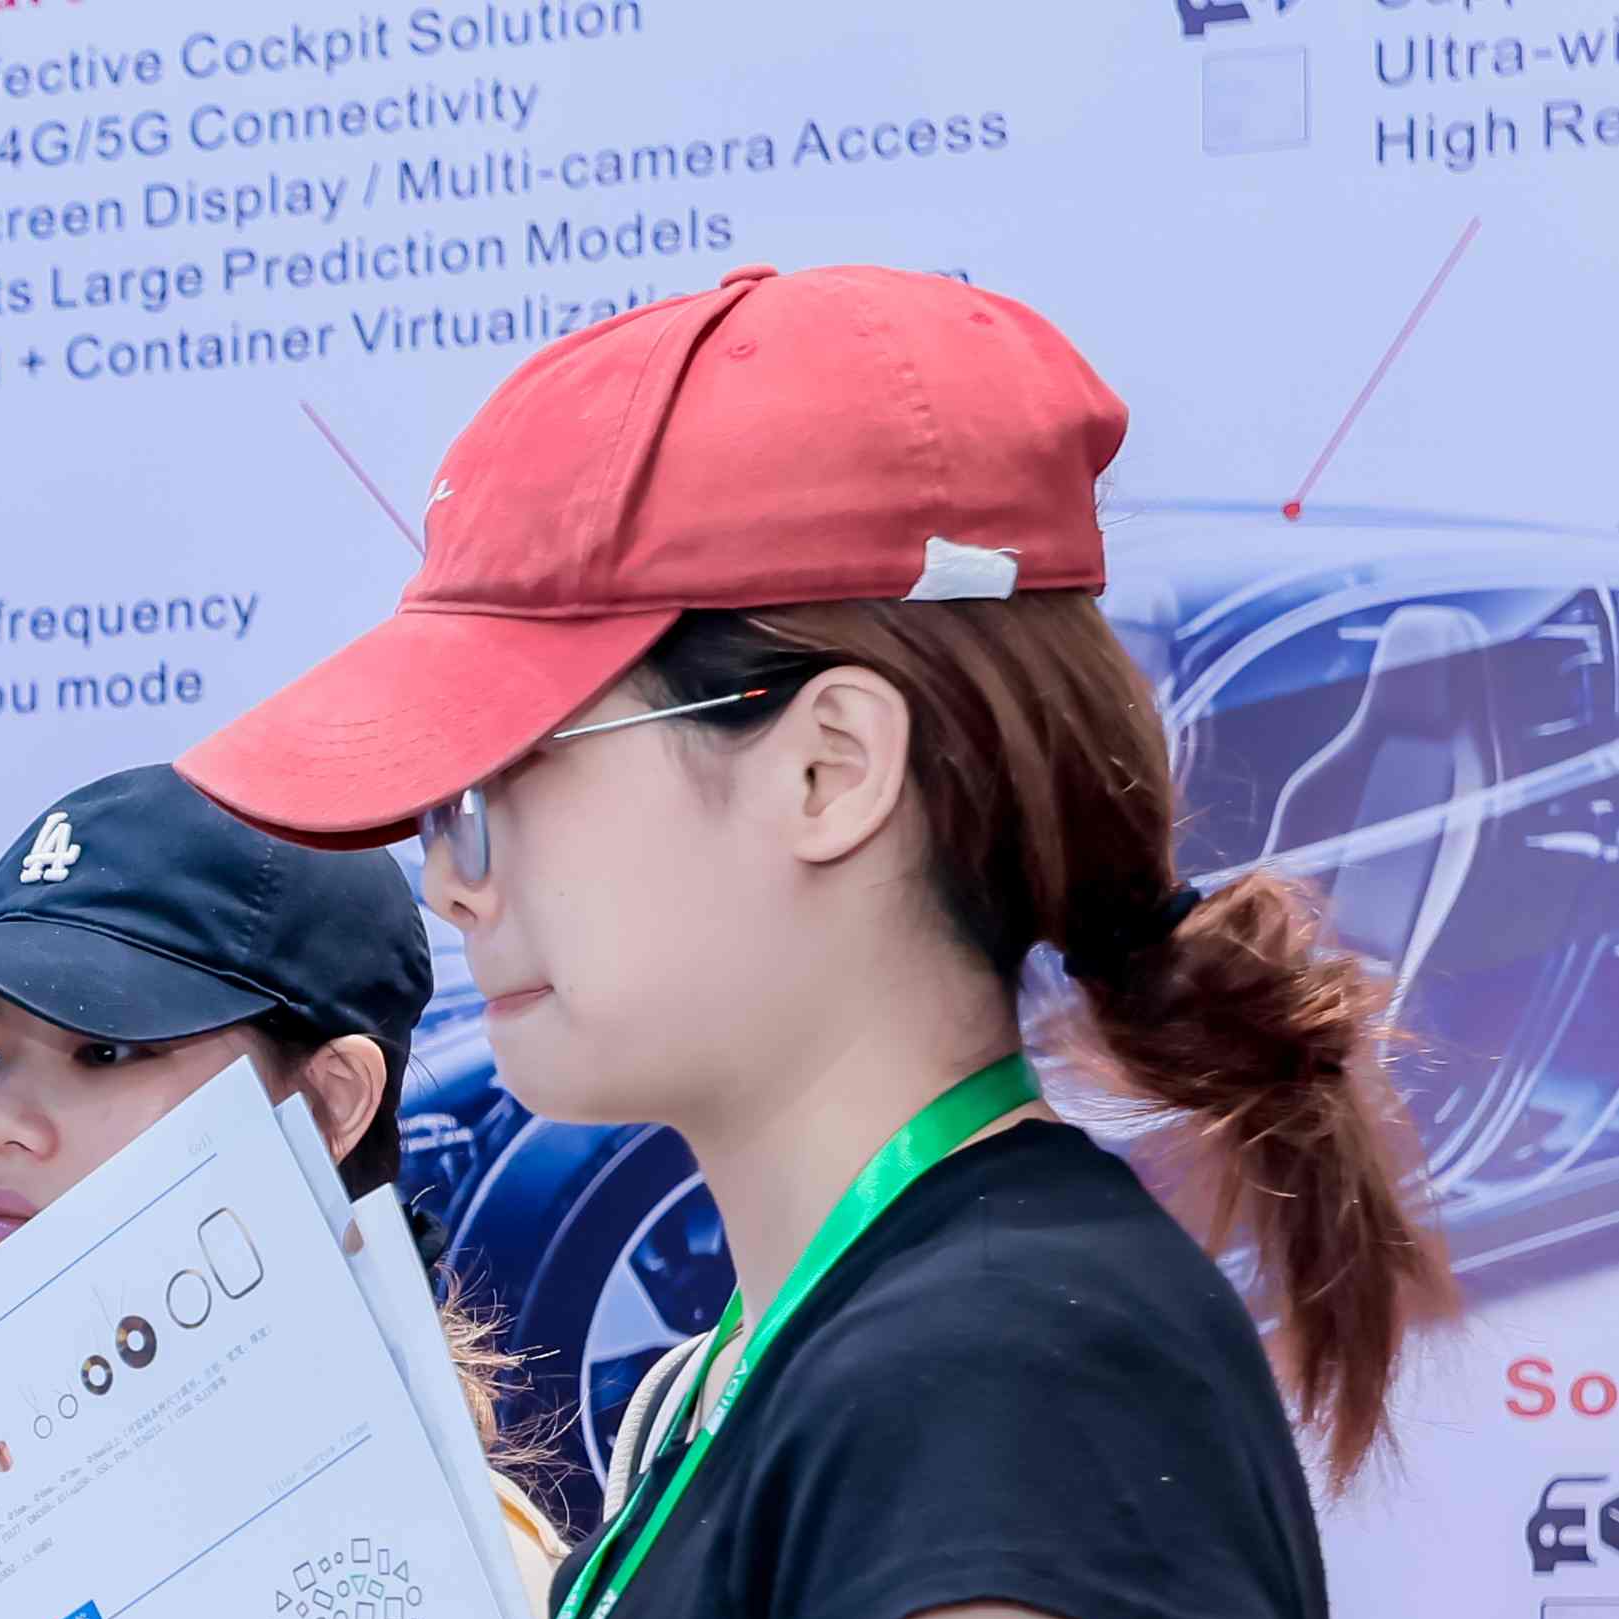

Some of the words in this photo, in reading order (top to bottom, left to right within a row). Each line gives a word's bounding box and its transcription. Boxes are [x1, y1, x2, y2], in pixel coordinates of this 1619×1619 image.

[181, 17, 390, 81] Cockpit
[408, 0, 643, 57] Solution
[189, 81, 539, 154] Connectivity
[1375, 106, 1517, 172] High
[144, 162, 346, 229] Display
[364, 162, 381, 208] /
[398, 132, 776, 203] Multi-camera
[793, 109, 1010, 167] Access
[53, 258, 204, 312] Large
[223, 222, 507, 292] Prediction
[526, 204, 735, 266] Models
[19, 349, 46, 377] +
[66, 315, 336, 382] Container
[352, 288, 695, 355] Virtualizat
[56, 660, 203, 711] mode
[20, 811, 81, 883] LA
[1505, 1358, 1618, 1418] So
